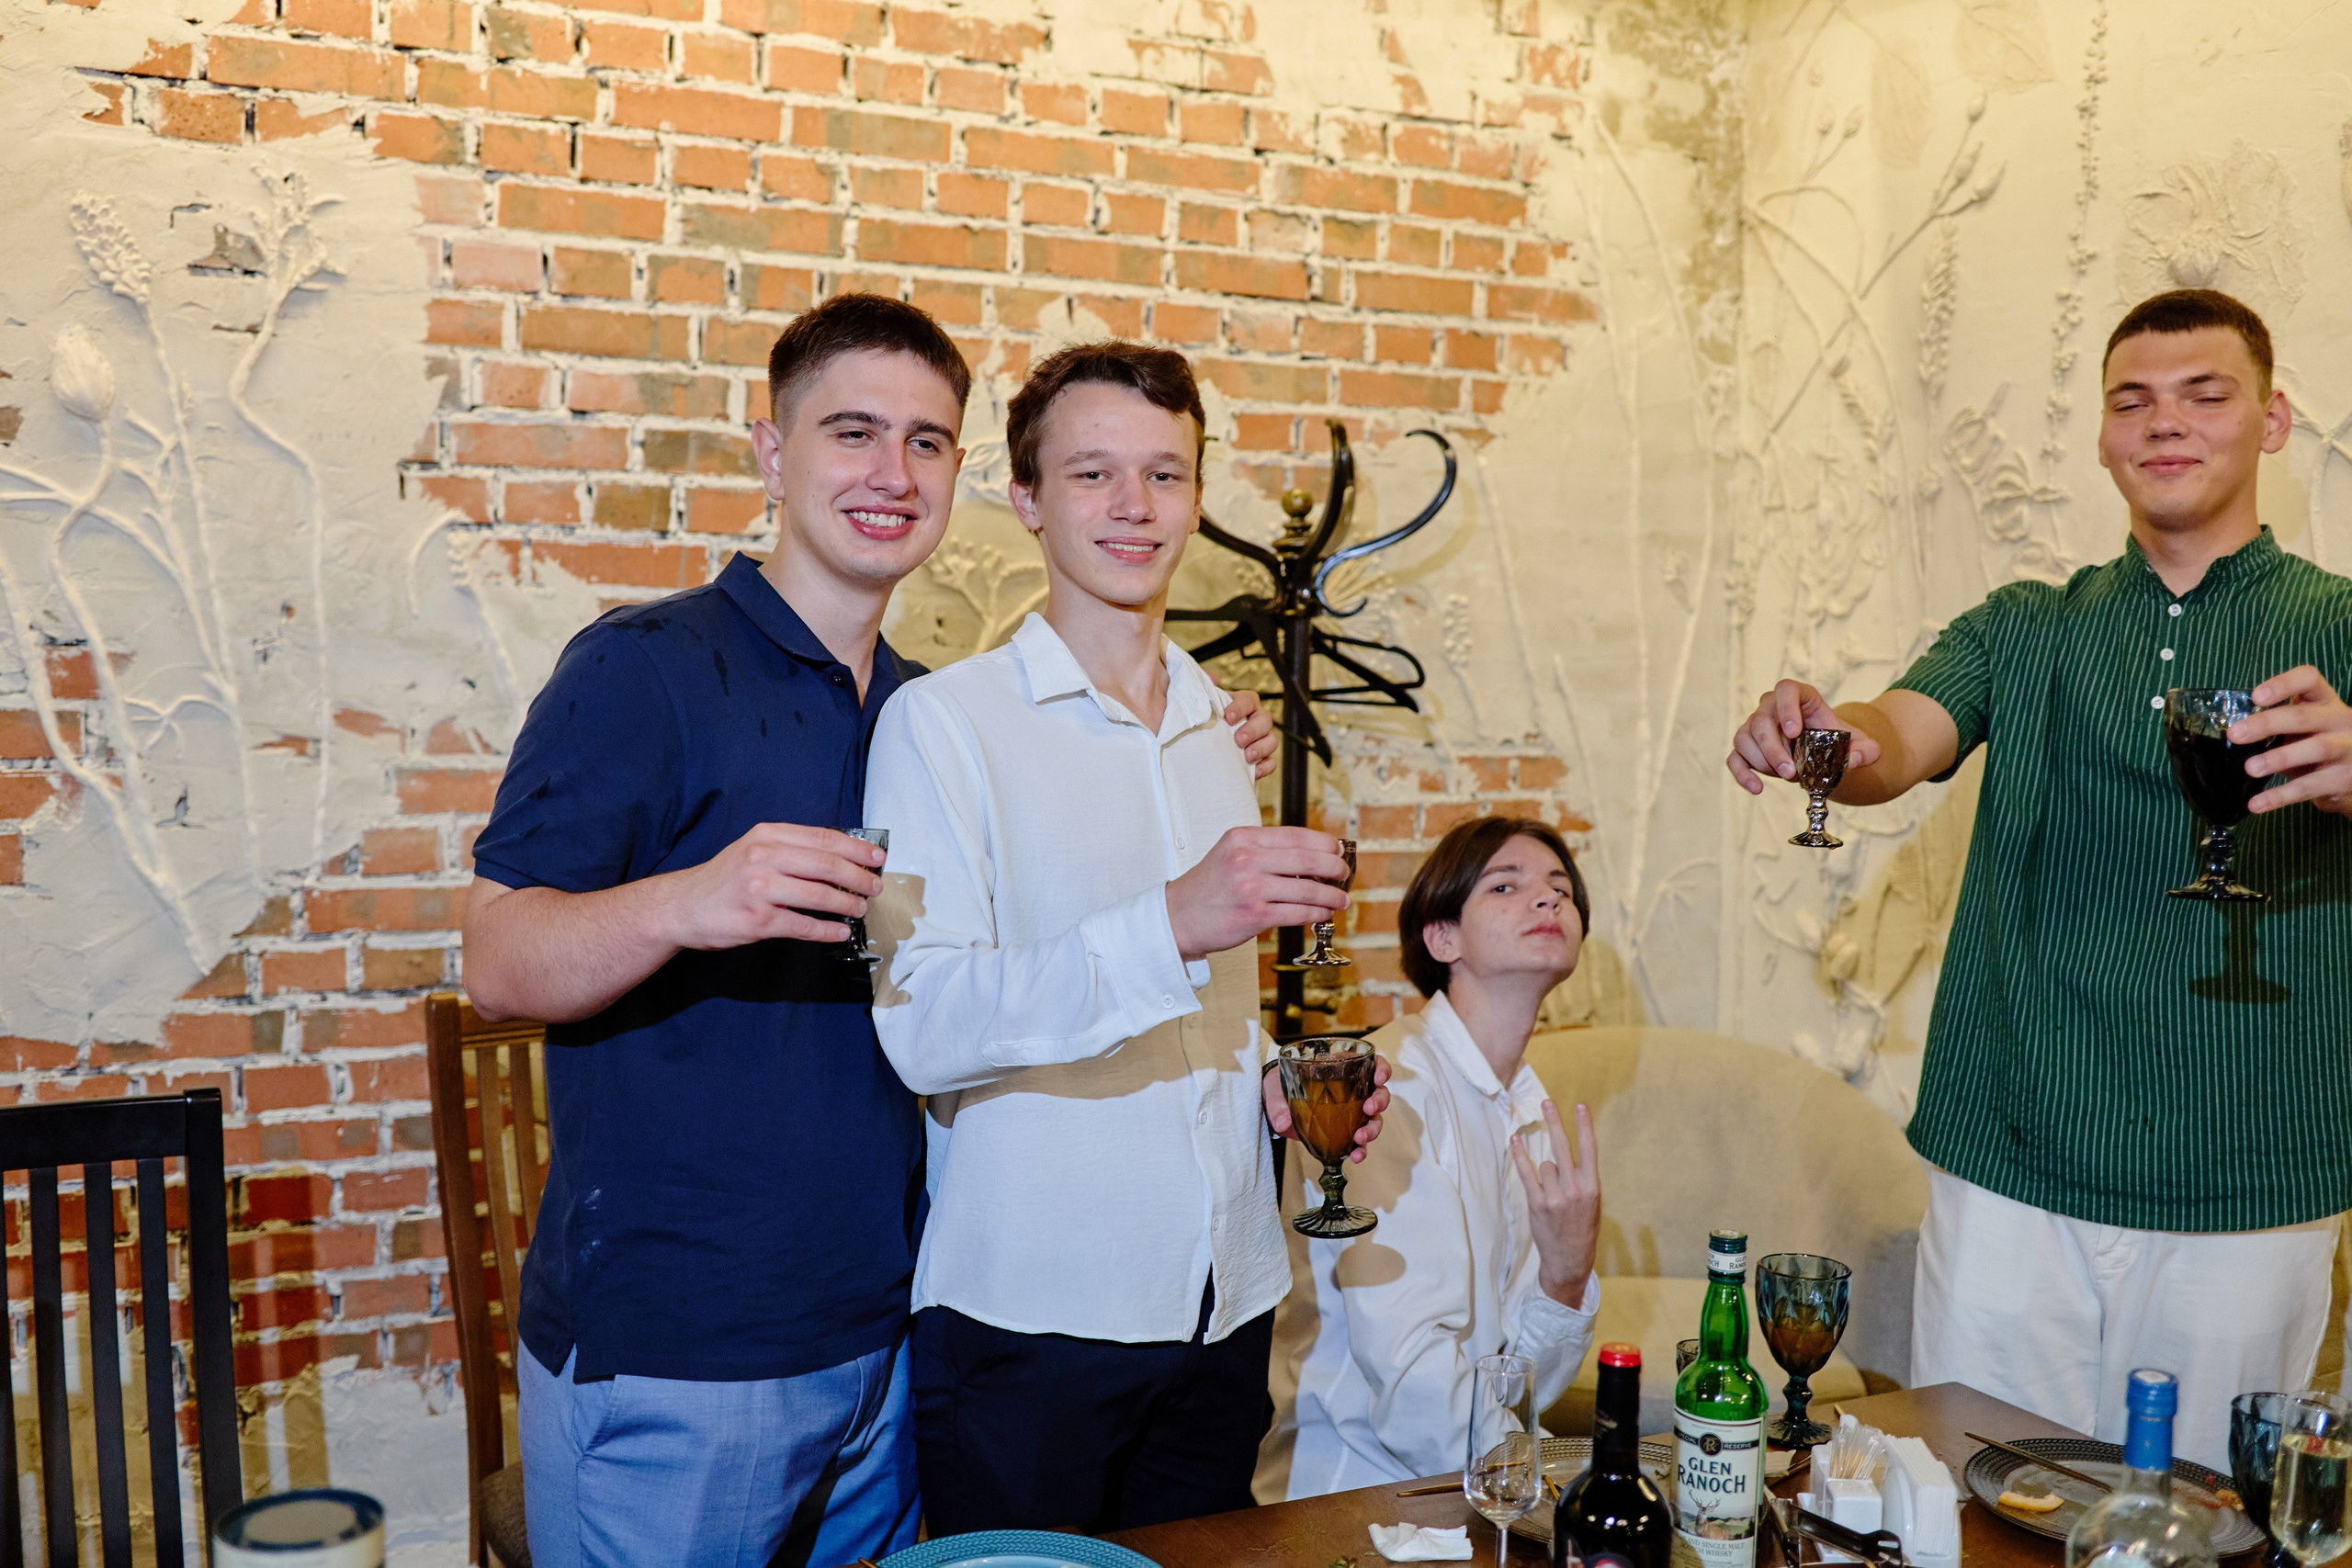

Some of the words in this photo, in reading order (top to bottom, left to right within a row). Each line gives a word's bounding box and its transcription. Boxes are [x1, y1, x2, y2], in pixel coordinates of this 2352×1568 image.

[1689, 1457, 1732, 1475] GLEN
[1678, 1463, 1746, 1494] RANOCH
[1702, 1541, 1727, 1550] SINGLE
[1728, 1541, 1745, 1550] MALT
[1705, 1550, 1734, 1558] WHISKY
